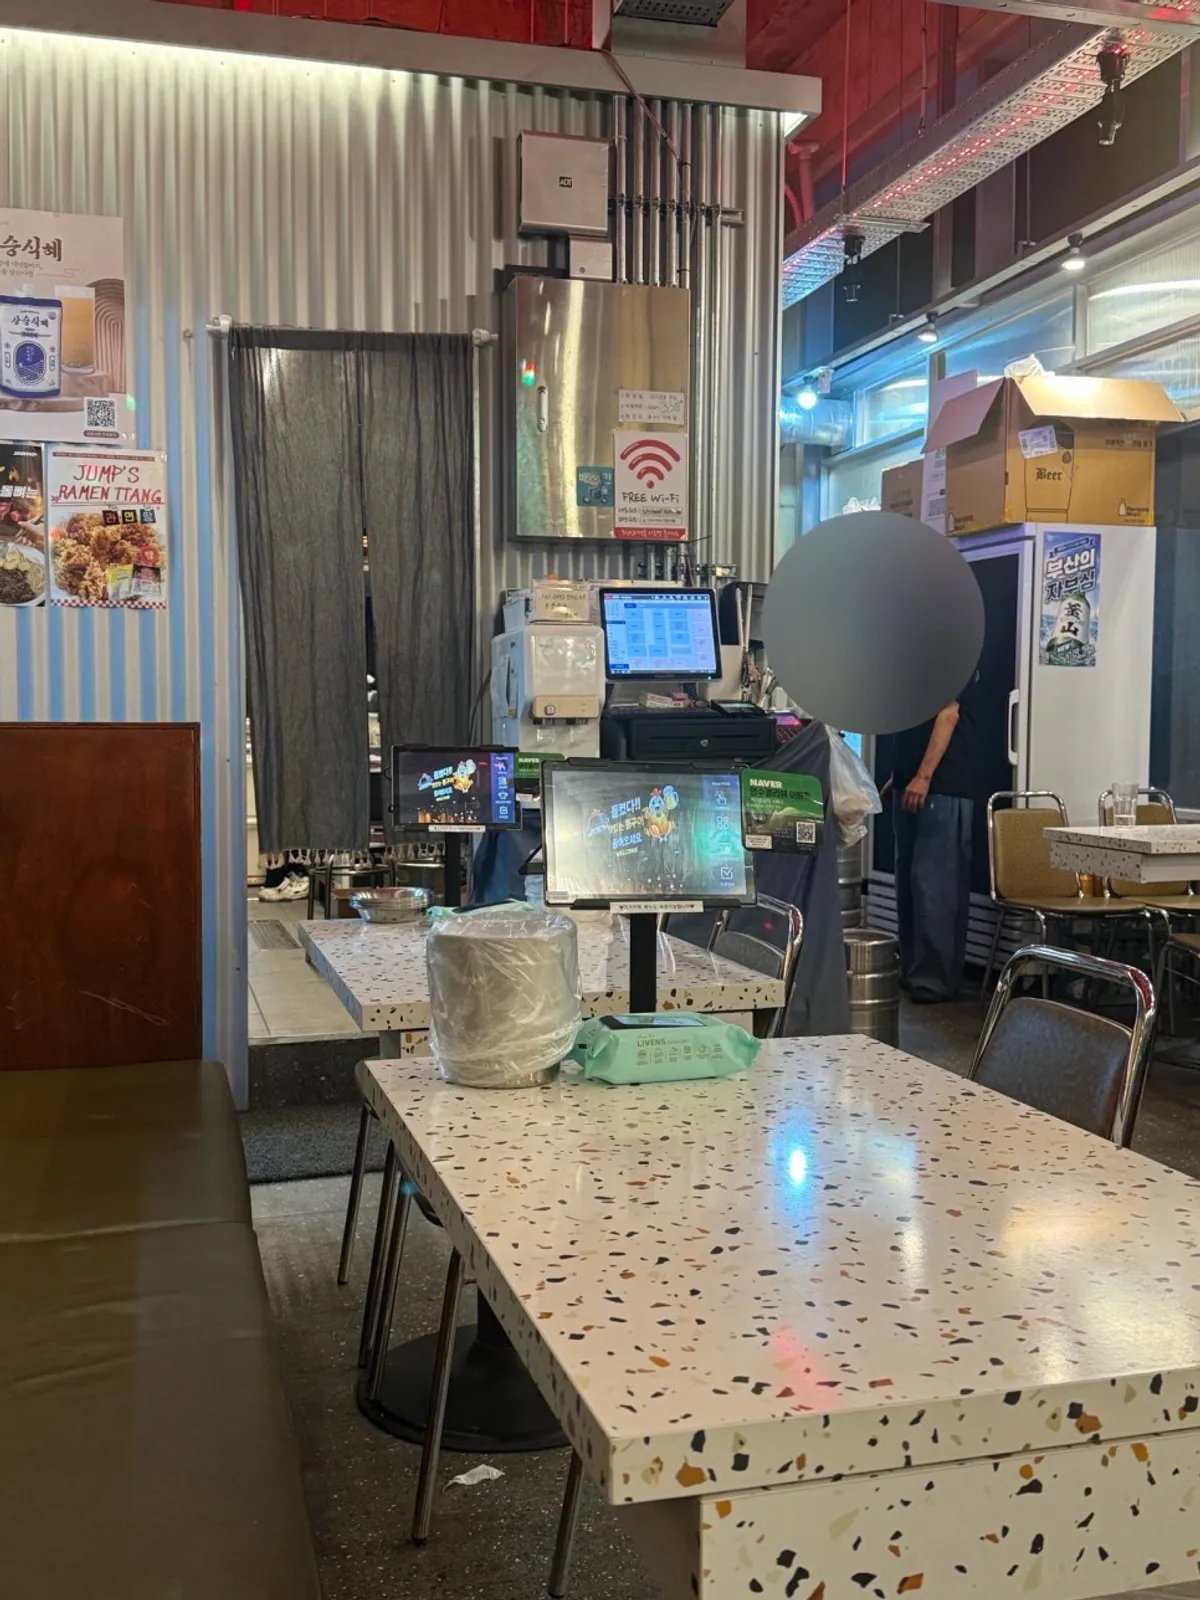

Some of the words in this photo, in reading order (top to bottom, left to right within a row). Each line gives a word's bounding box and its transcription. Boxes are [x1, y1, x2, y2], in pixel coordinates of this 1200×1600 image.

[73, 465, 139, 483] JUMP'S
[1035, 467, 1062, 482] Beer
[58, 485, 110, 501] RAMEN
[114, 487, 162, 504] TTANG
[622, 491, 647, 503] FREE
[651, 493, 680, 504] Wi-Fi
[1046, 548, 1095, 579] 부산의
[749, 778, 783, 789] NAVER
[637, 1038, 666, 1047] LIVENS
